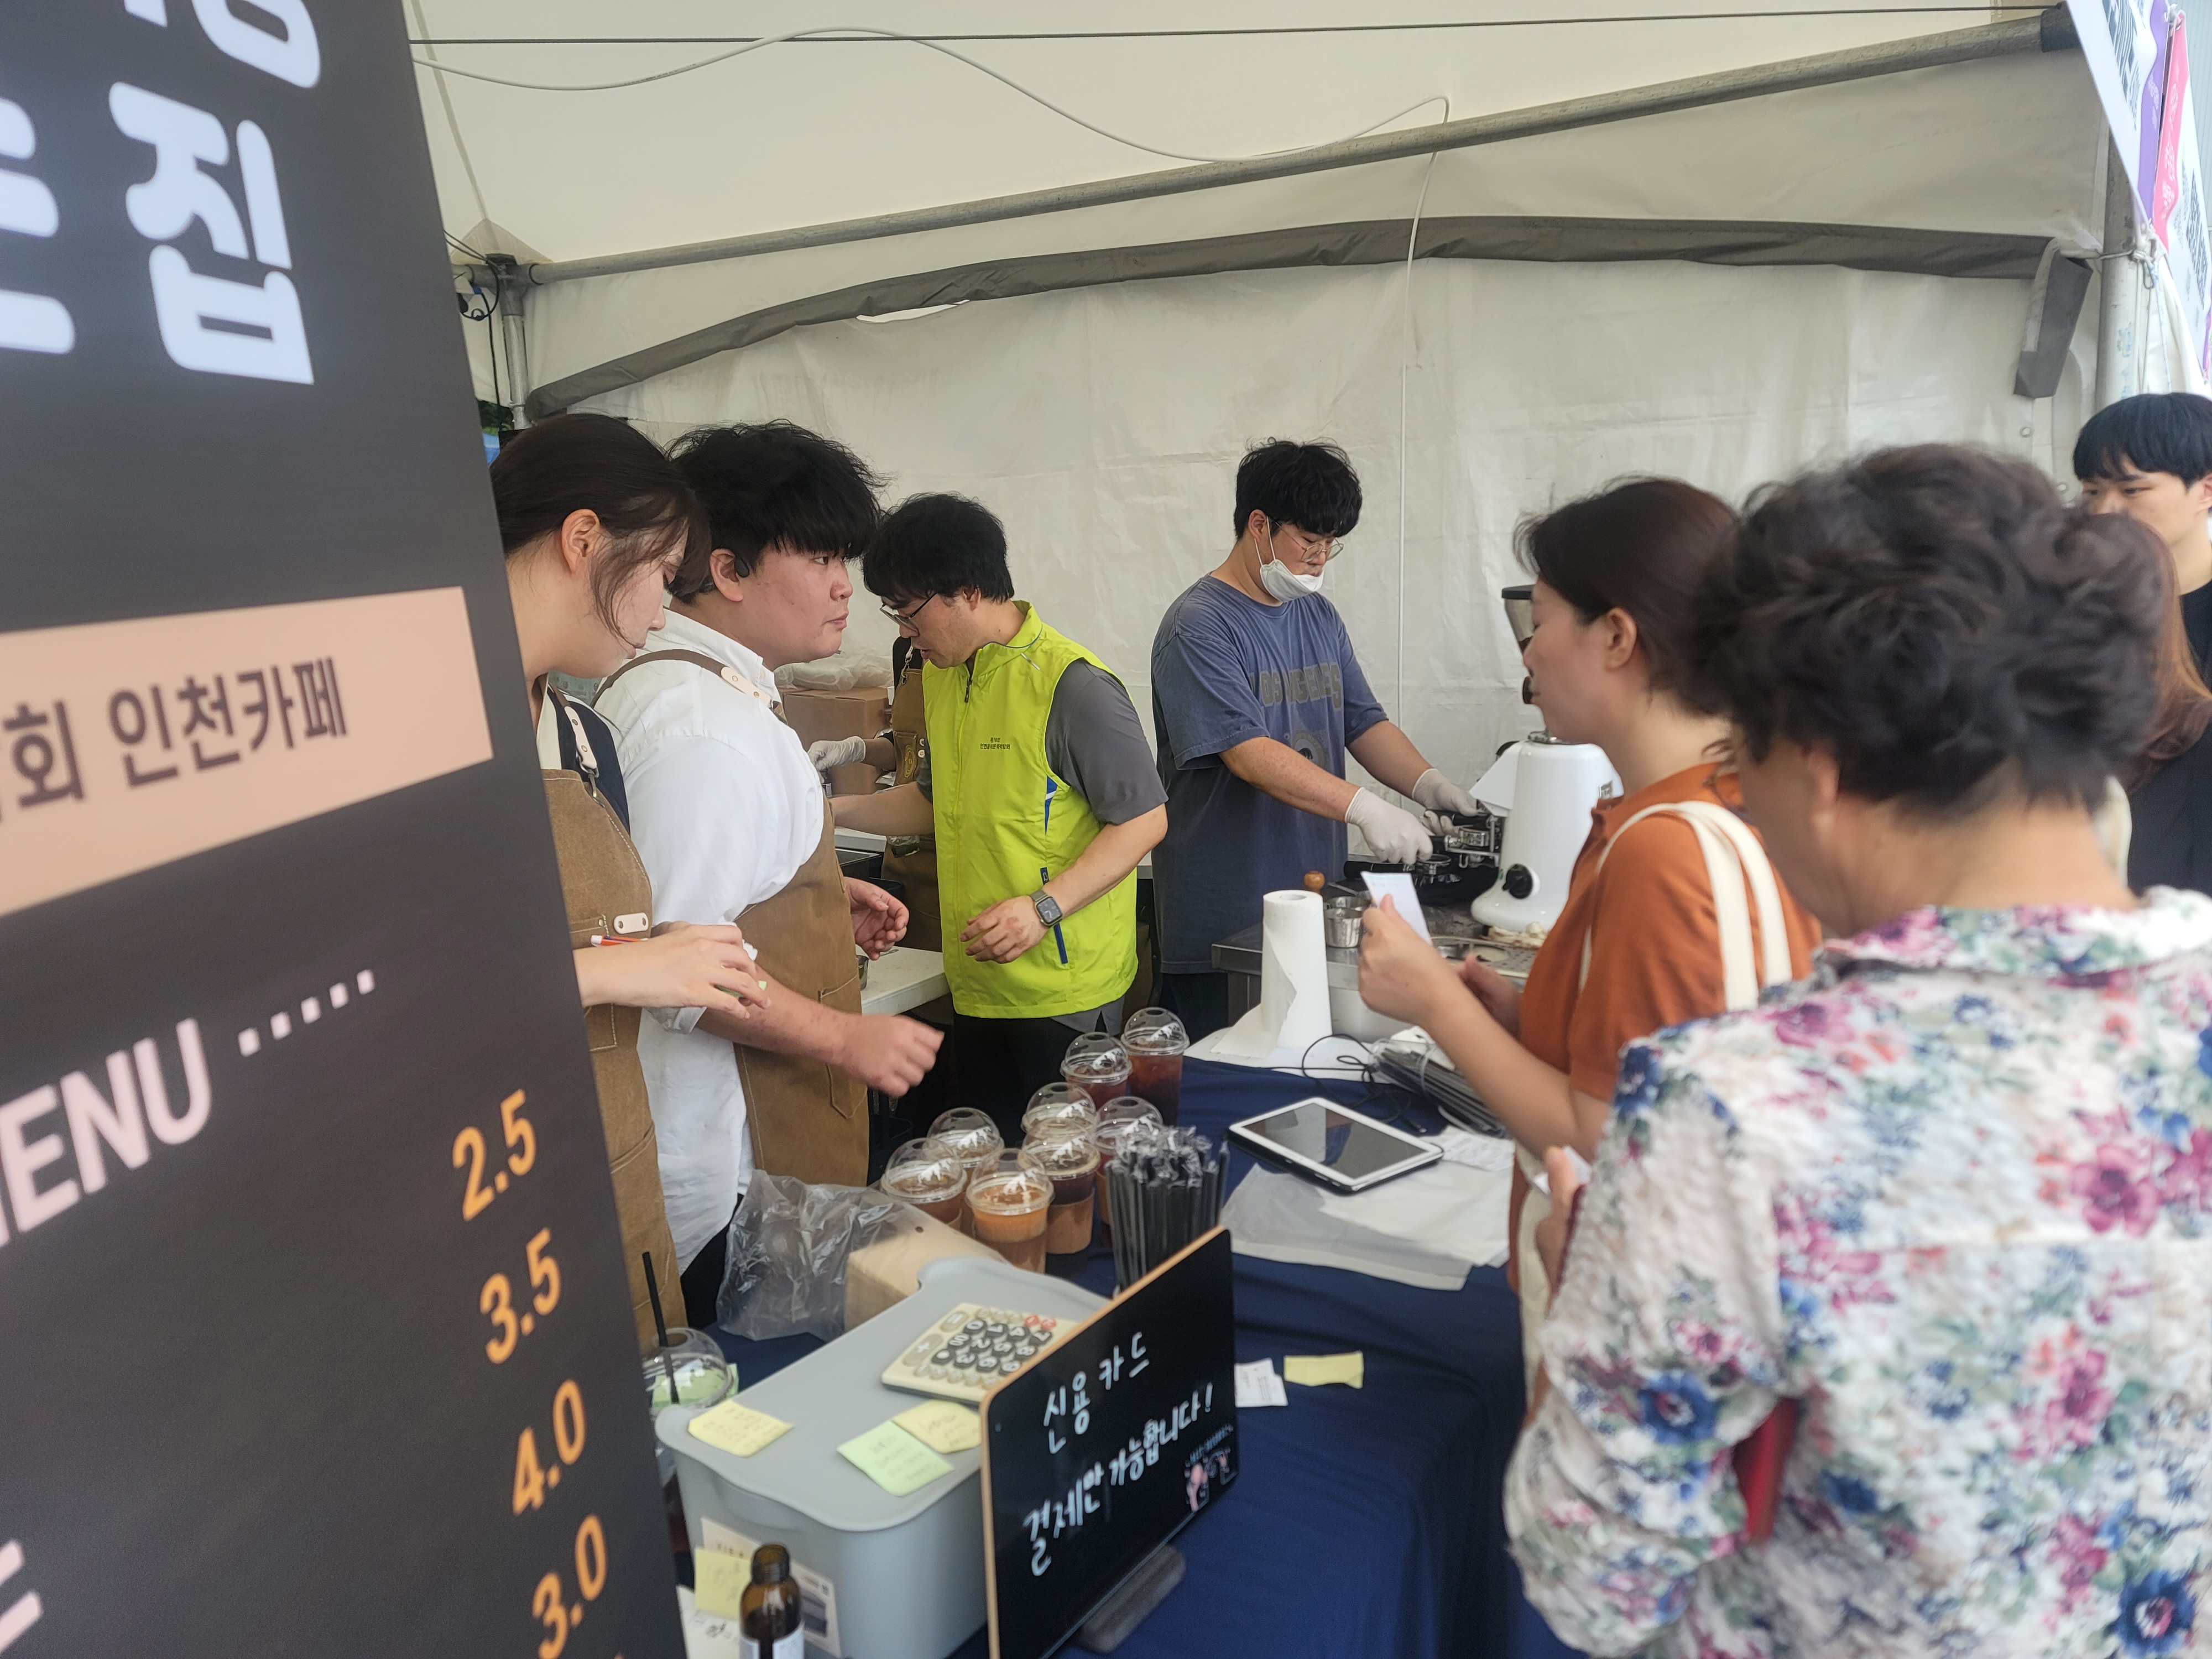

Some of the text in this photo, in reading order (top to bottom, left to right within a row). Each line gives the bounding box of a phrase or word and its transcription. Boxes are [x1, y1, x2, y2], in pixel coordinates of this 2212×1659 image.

[0, 657, 347, 810] 회 인천카페
[1249, 670, 1282, 707] OS
[0, 1019, 211, 1246] ENU
[452, 1089, 536, 1220] 2.5
[480, 1229, 561, 1363] 3.5
[512, 1380, 585, 1515] 4.0
[1043, 1371, 1091, 1454] 신용
[1098, 1331, 1150, 1390] 카드
[1022, 1460, 1105, 1576] 결제만
[532, 1515, 607, 1659] 3.0
